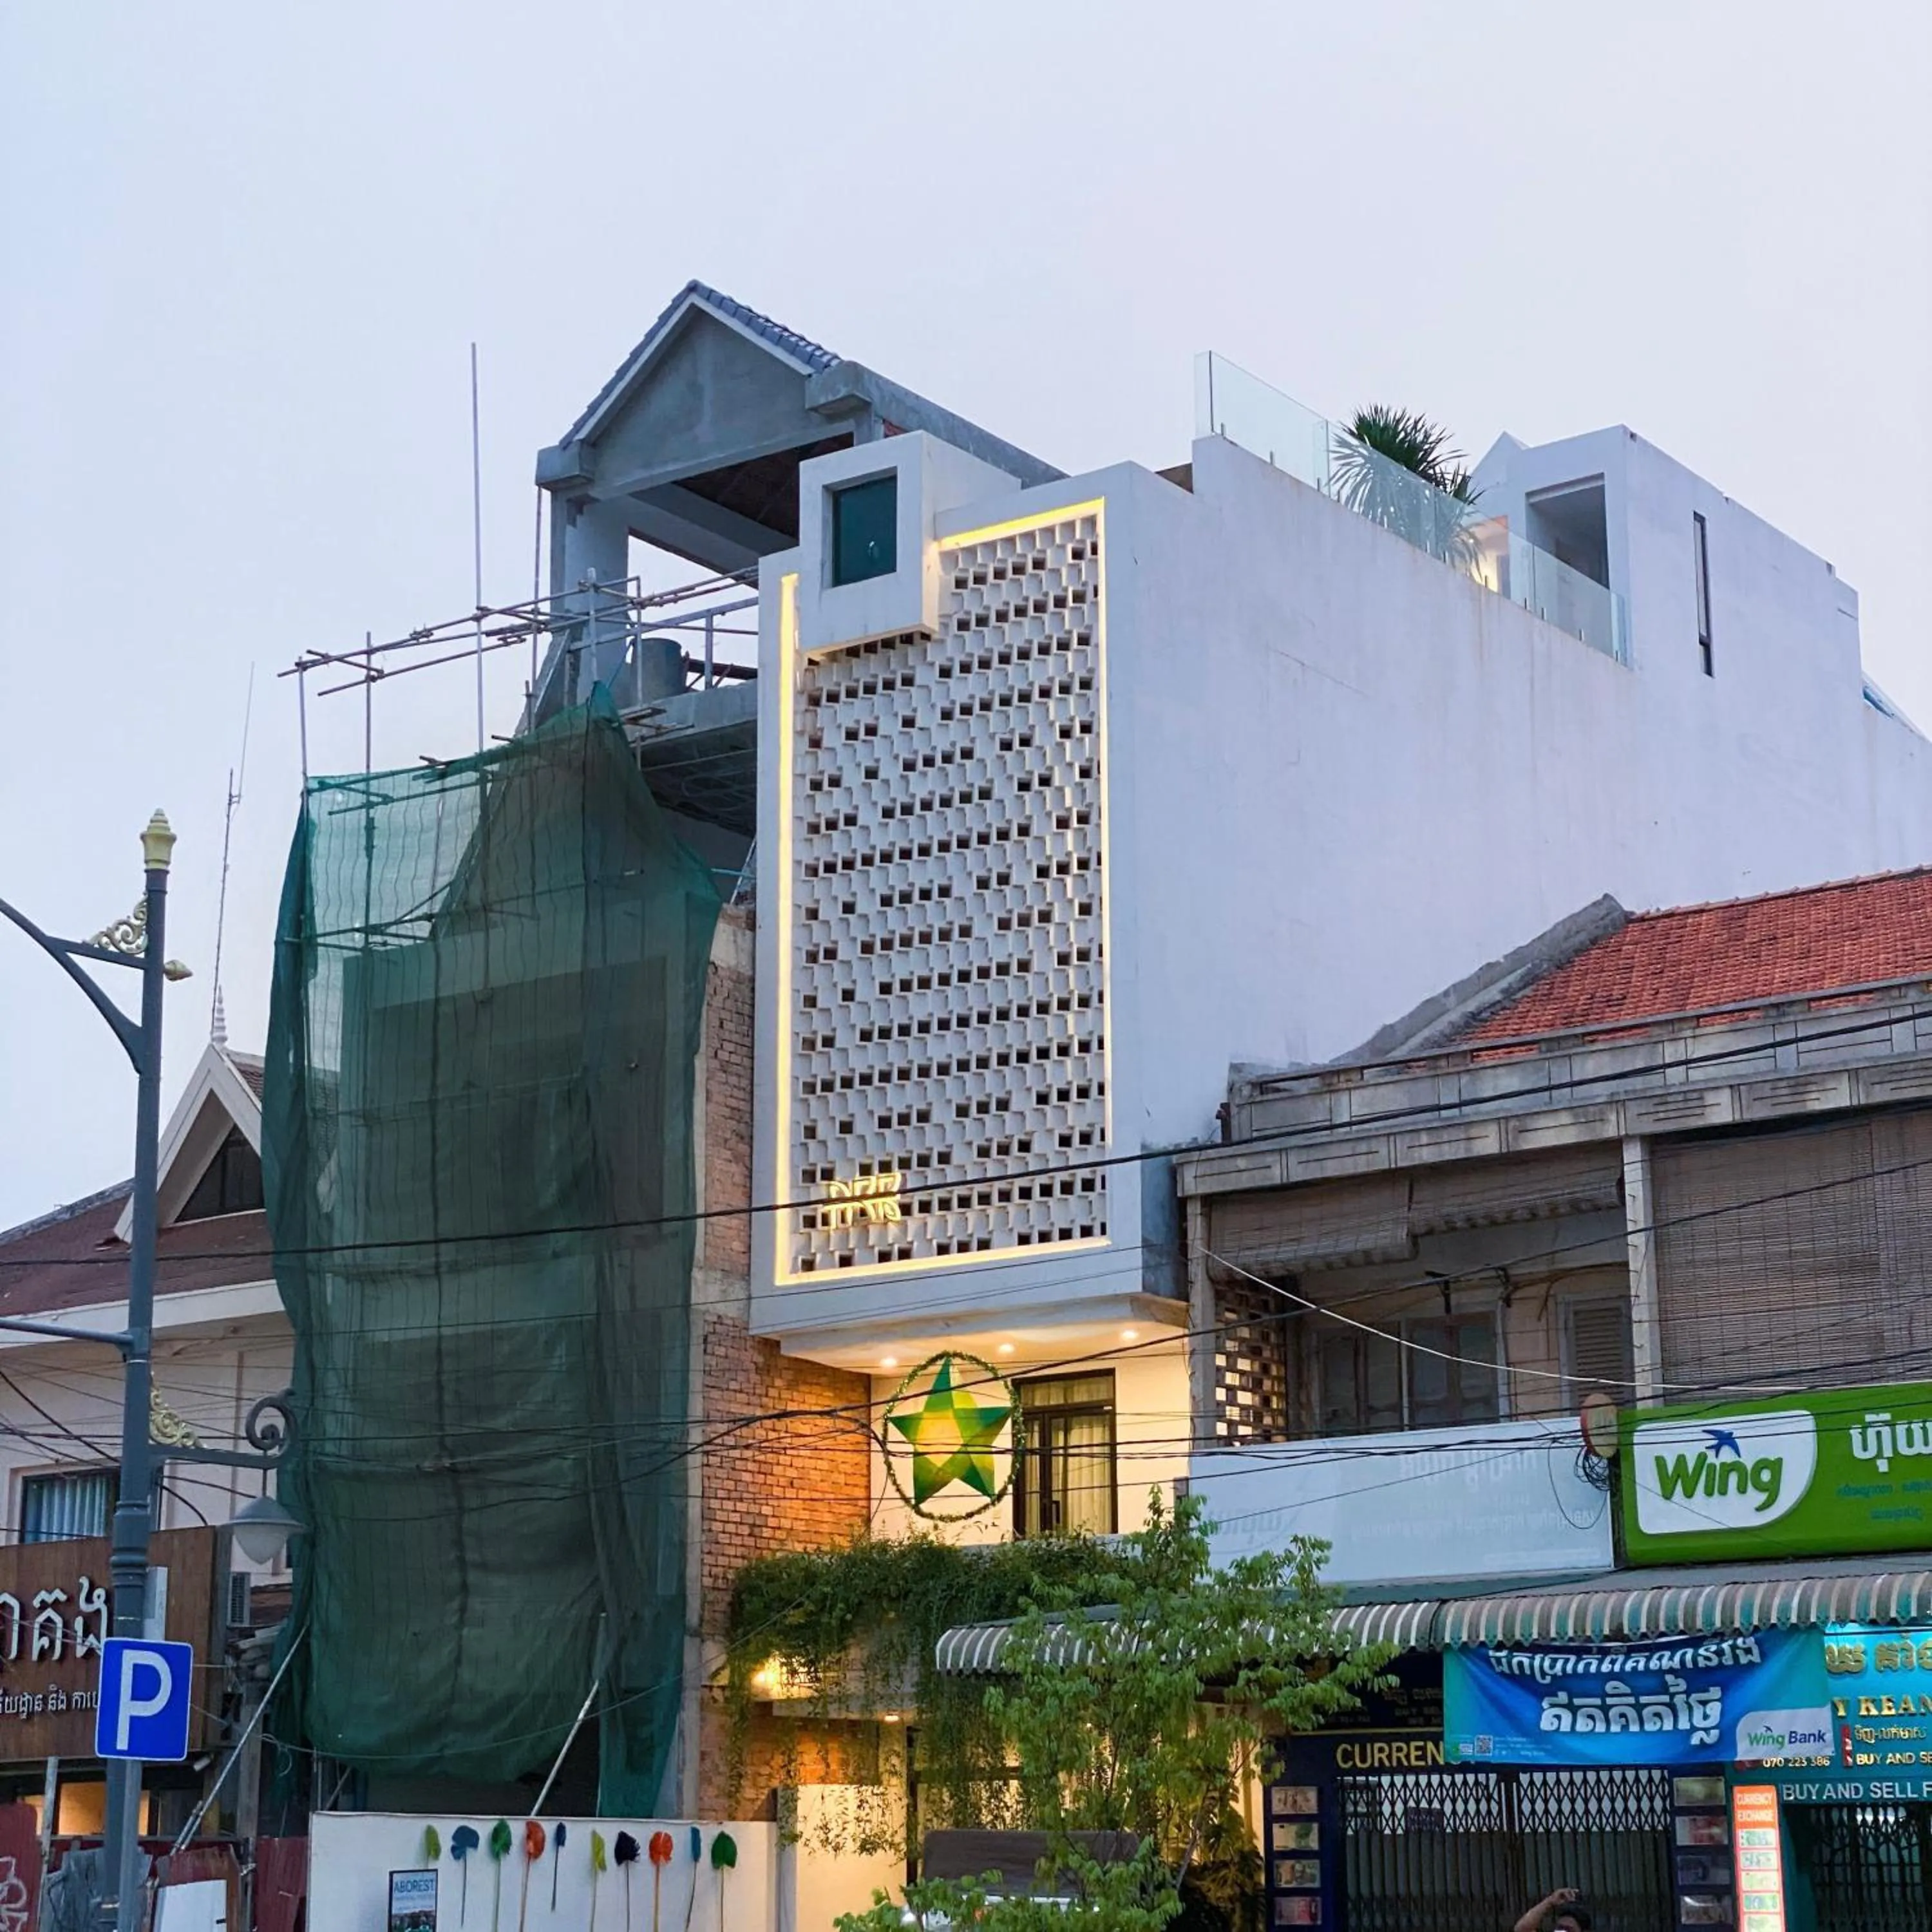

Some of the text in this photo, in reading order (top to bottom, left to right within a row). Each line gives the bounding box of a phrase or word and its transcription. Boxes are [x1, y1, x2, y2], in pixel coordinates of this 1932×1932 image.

[1654, 1452, 1783, 1511] Wing
[116, 1649, 173, 1750] P
[1747, 1730, 1826, 1750] Wing Bank
[1336, 1741, 1475, 1768] CURREN
[1763, 1757, 1785, 1767] 070
[1856, 1753, 1882, 1765] BUY
[1886, 1752, 1916, 1765] AND
[1782, 1783, 1819, 1801] BUY
[1823, 1783, 1863, 1800] AND
[1869, 1782, 1918, 1799] SELL
